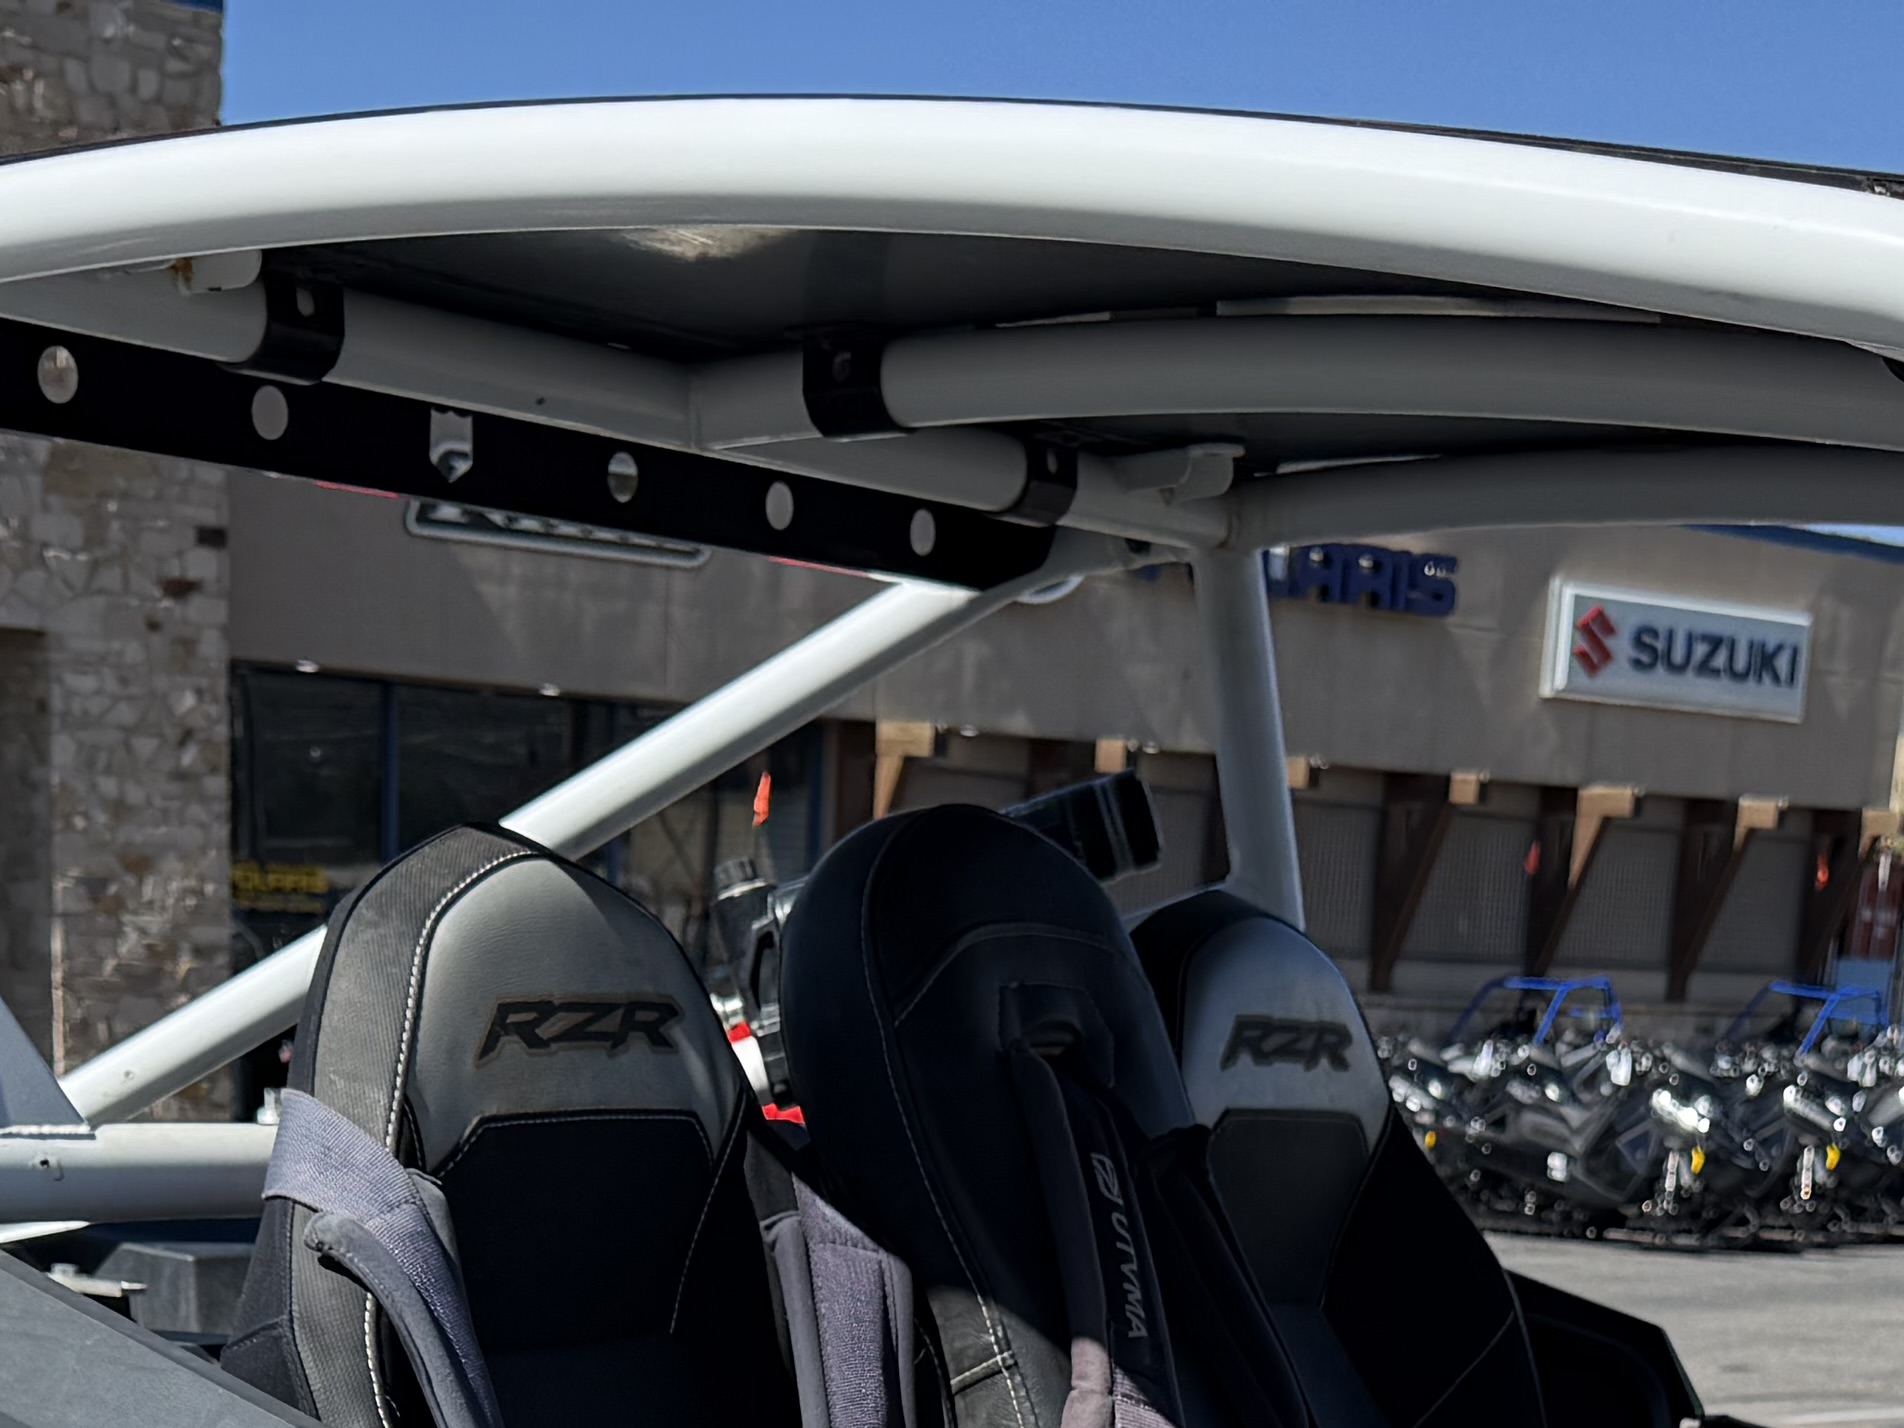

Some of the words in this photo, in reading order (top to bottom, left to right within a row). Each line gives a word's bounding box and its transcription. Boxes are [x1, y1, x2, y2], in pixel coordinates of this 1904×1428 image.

[1627, 624, 1799, 688] SUZUKI
[475, 998, 683, 1065] RZR
[1220, 1014, 1353, 1072] RZR
